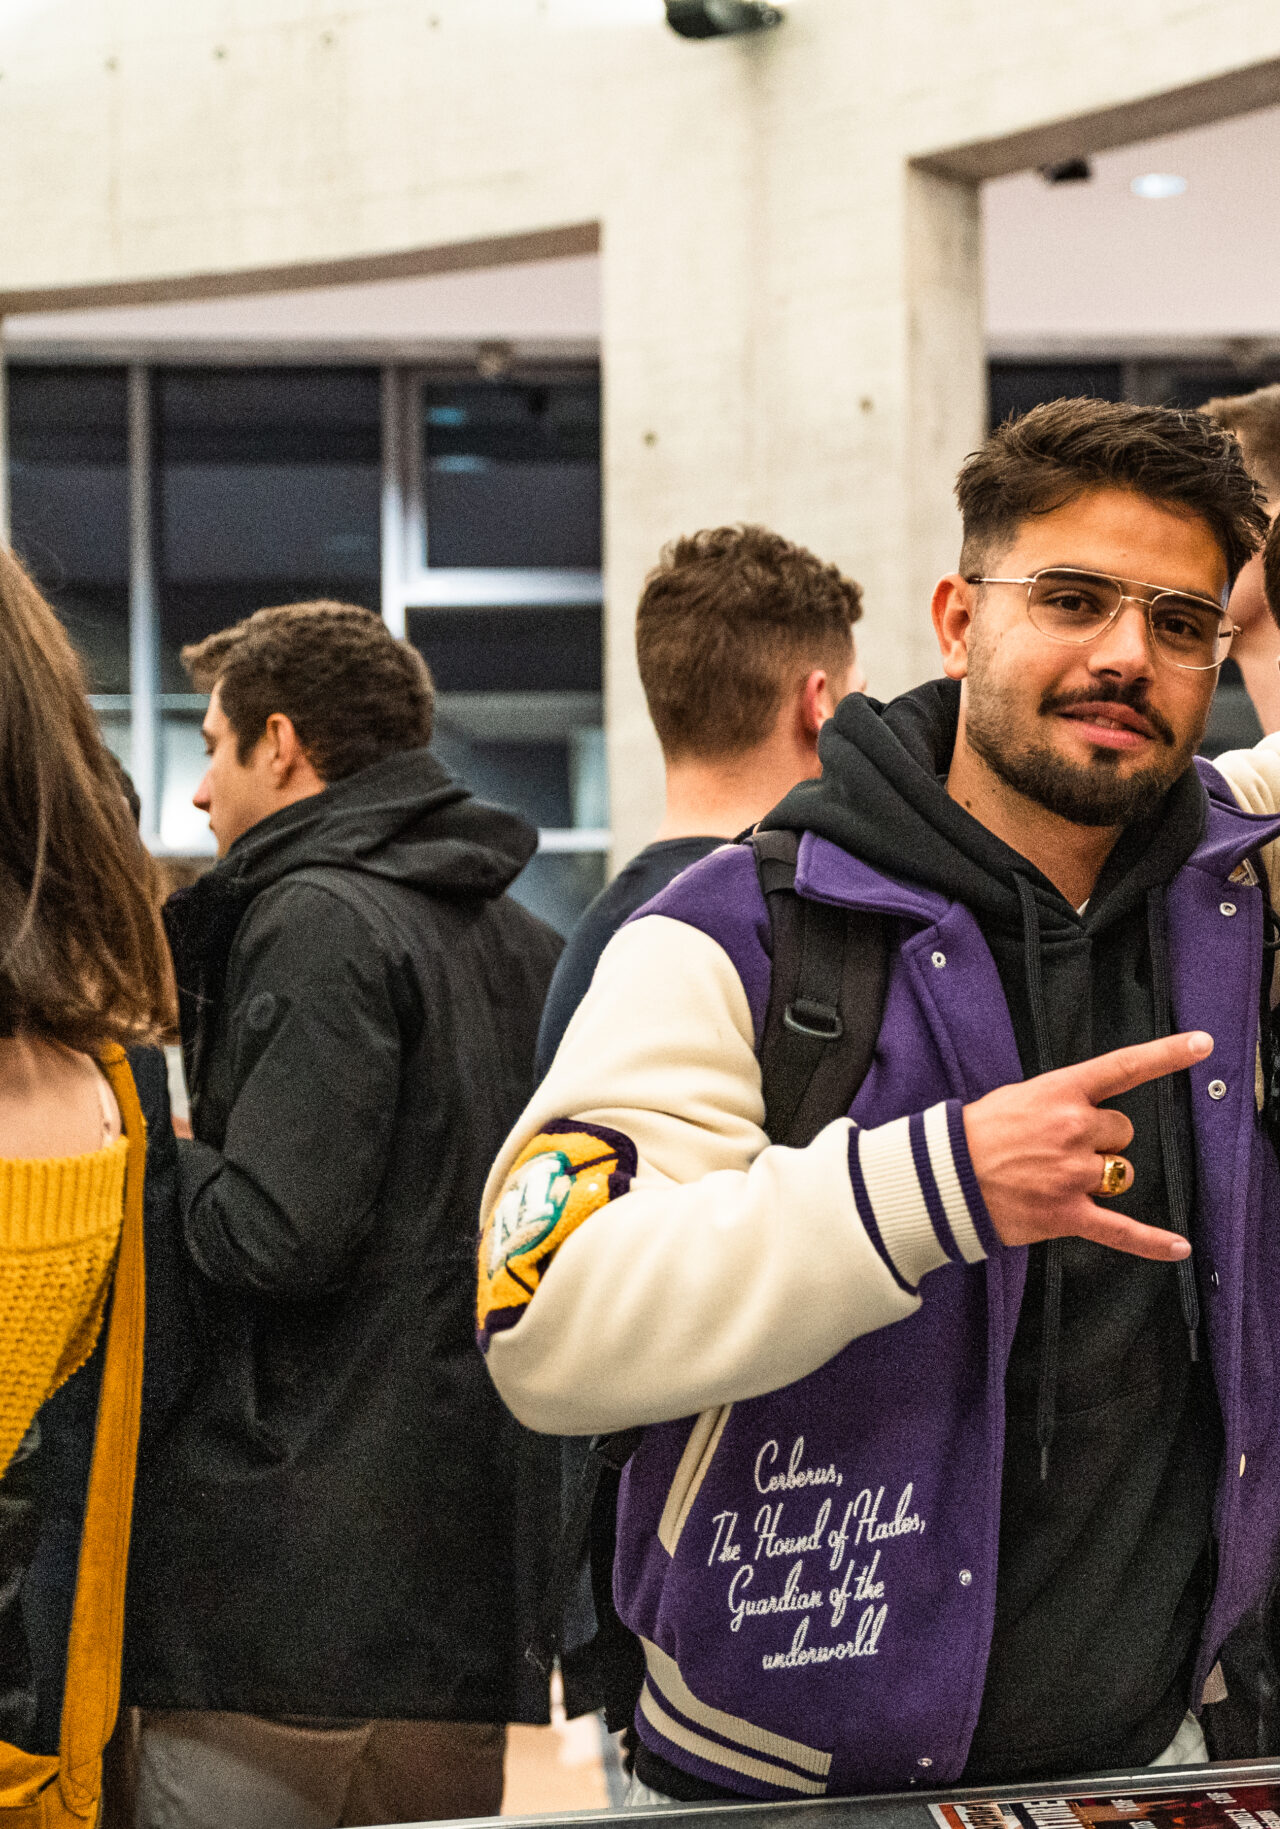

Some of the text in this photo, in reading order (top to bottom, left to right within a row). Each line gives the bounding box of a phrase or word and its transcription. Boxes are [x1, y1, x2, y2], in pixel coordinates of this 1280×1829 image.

[754, 1435, 843, 1494] Cerberus,
[708, 1482, 926, 1570] The Hound of Hades,
[728, 1549, 885, 1632] Guardian of the
[762, 1603, 888, 1670] underworld
